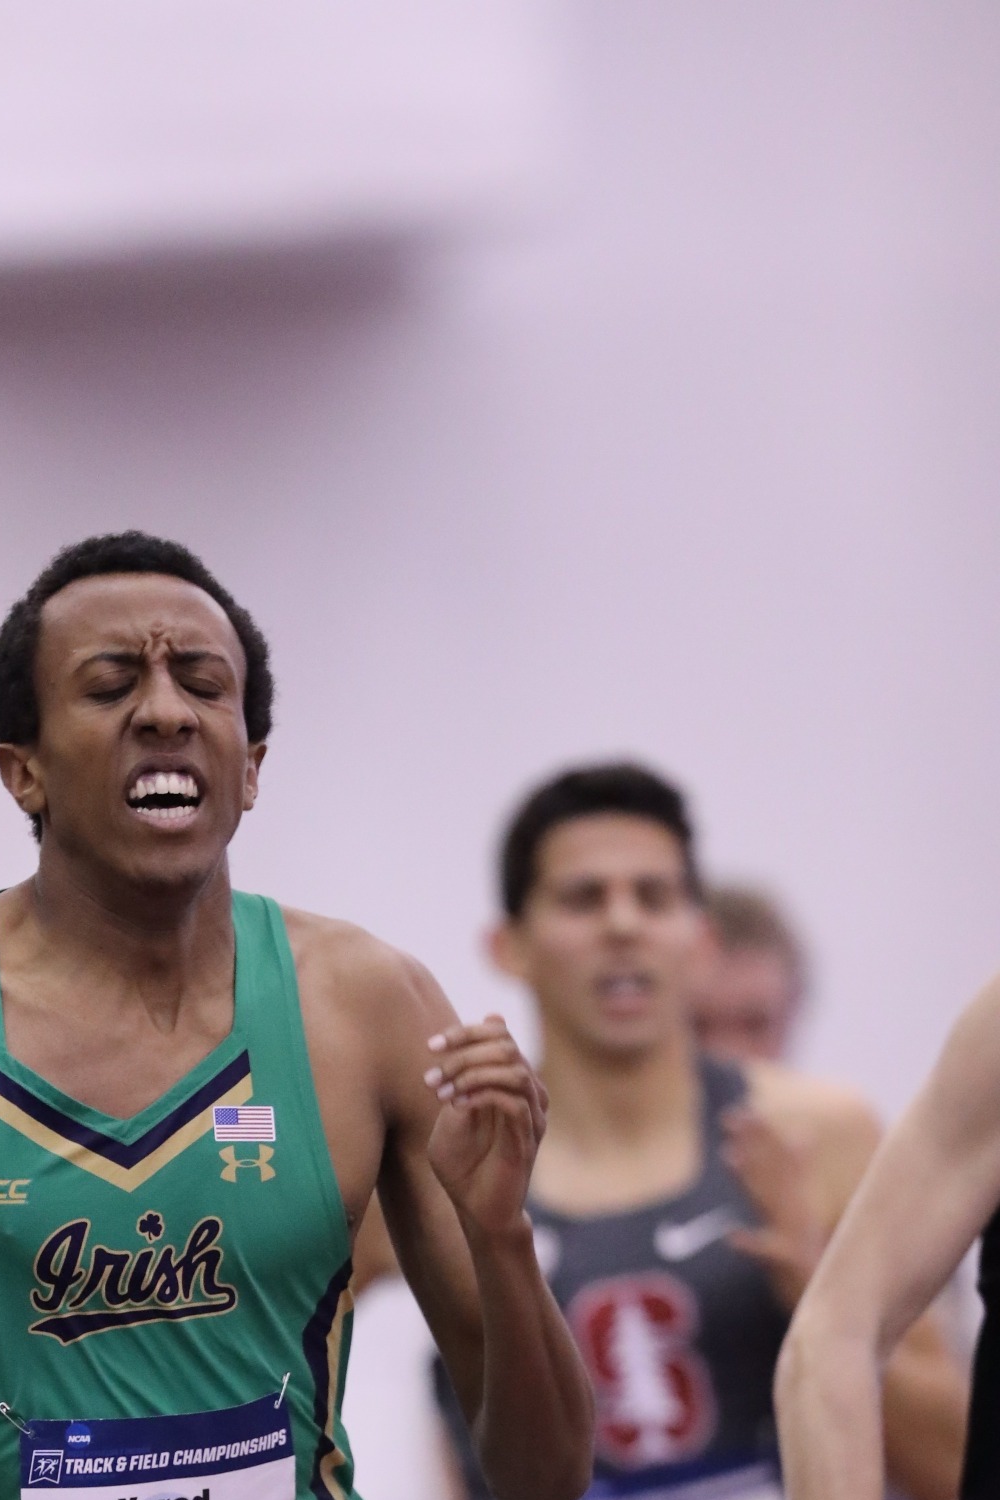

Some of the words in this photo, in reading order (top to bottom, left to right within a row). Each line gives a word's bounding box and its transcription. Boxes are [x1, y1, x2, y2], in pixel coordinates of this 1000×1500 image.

[29, 1211, 238, 1332] Irish
[65, 1457, 115, 1475] TRACK
[115, 1456, 128, 1473] &
[129, 1451, 168, 1472] FIELD
[173, 1428, 287, 1465] CHAMPIONSHIPS
[67, 1434, 91, 1443] NCAA
